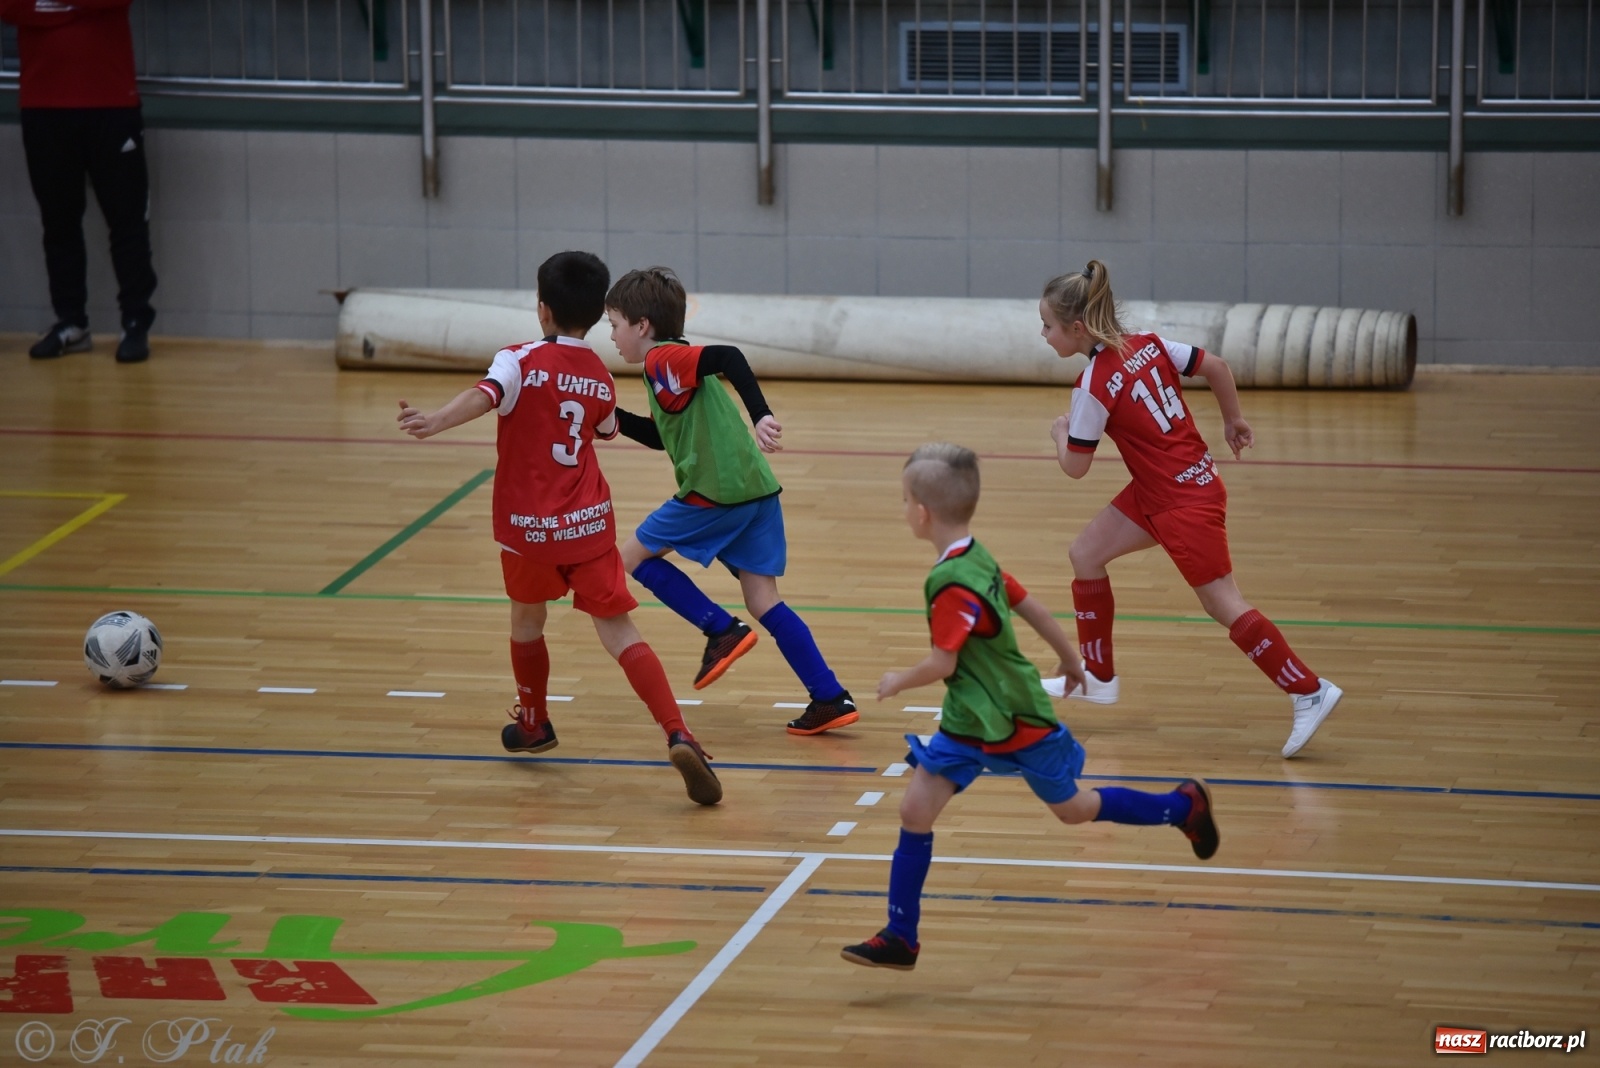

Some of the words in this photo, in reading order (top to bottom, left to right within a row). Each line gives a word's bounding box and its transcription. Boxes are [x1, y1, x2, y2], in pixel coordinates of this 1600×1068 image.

[522, 369, 549, 387] AP
[1106, 371, 1124, 398] AP
[1130, 366, 1186, 434] 14
[552, 400, 585, 466] 3
[553, 518, 606, 541] WIELKIEGO
